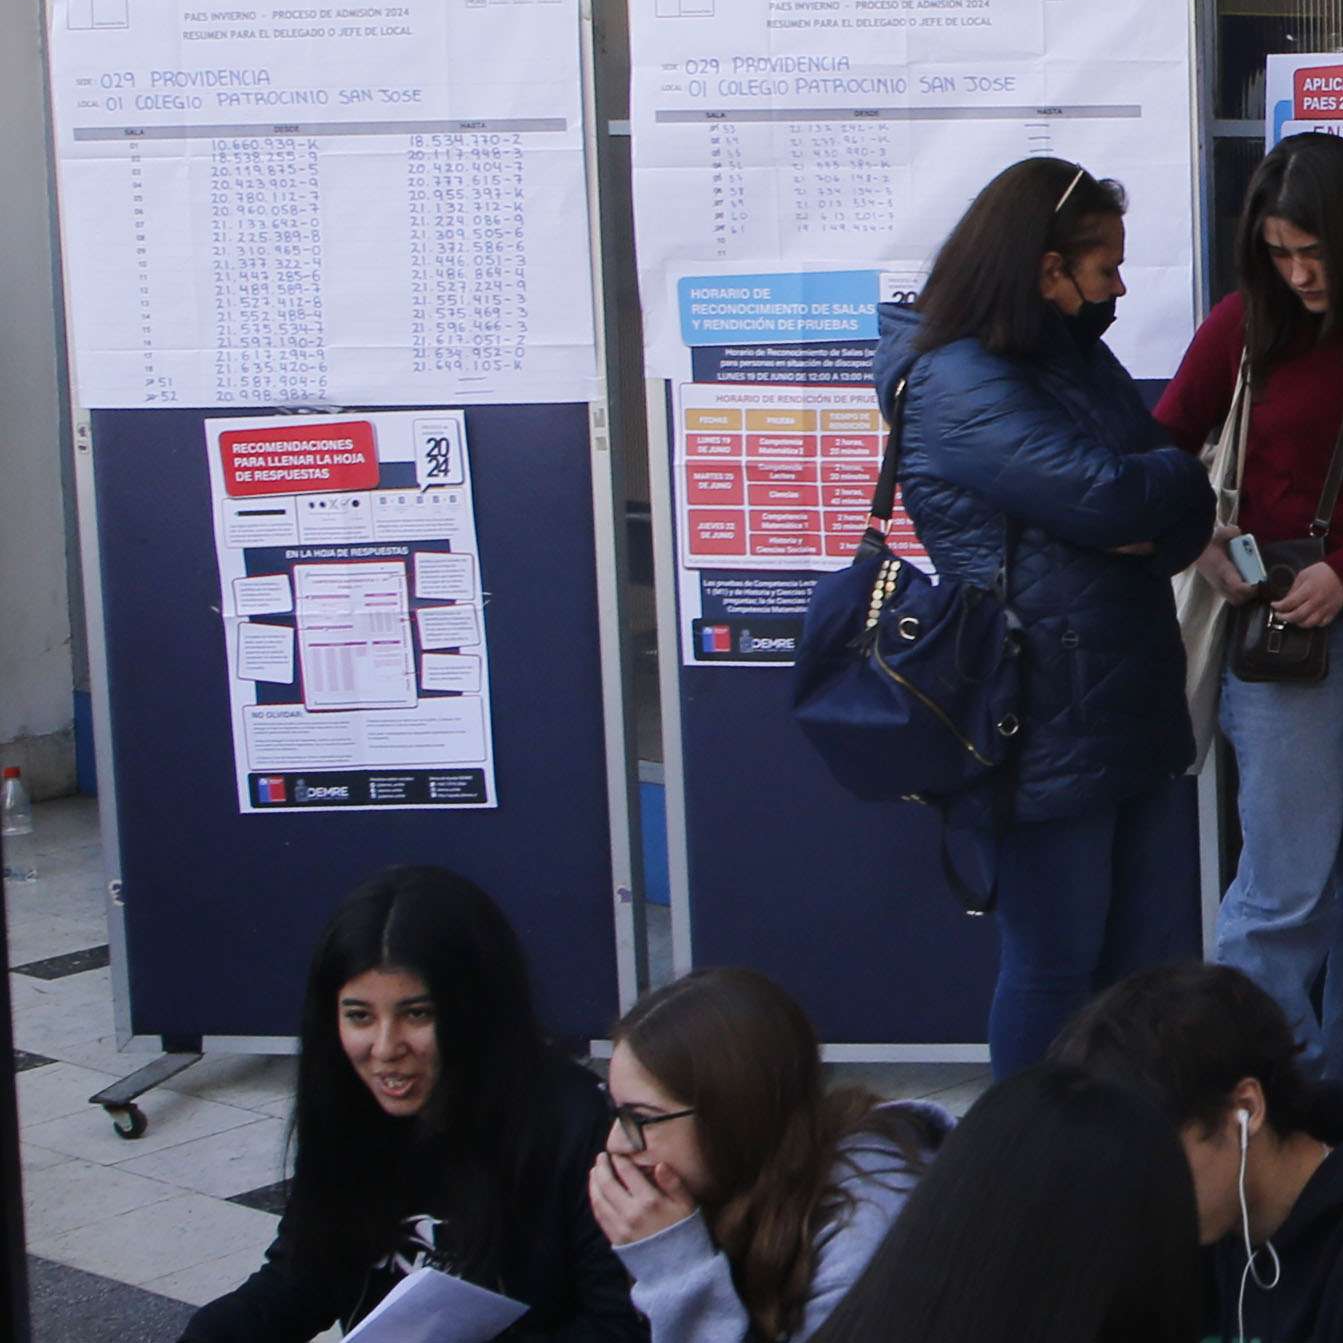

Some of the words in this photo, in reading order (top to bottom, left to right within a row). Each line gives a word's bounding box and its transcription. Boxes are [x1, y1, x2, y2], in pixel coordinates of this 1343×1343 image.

[769, 3, 792, 11] PAES
[795, 1, 840, 10] INVIERNO
[855, 1, 898, 10] PROCESO
[901, 0, 914, 8] DE
[966, 0, 990, 8] 2024
[211, 11, 256, 21] INVIERNO
[272, 10, 316, 20] PROCESO
[320, 9, 332, 18] DE
[385, 8, 410, 17] 2024
[766, 19, 811, 29] RESUMEN
[813, 19, 839, 28] PARA
[841, 19, 853, 27] EL
[856, 18, 906, 28] DELEGADO
[909, 18, 916, 26] O
[919, 17, 943, 26] JEFE
[945, 17, 958, 26] DE
[960, 17, 991, 26] LOCAL
[183, 30, 227, 40] RESUMEN
[230, 30, 255, 39] PARA
[258, 29, 270, 39] EL
[273, 28, 325, 39] DELEGADO
[328, 28, 335, 37] O
[338, 28, 362, 37] JEFE
[365, 27, 377, 36] DE
[381, 27, 412, 36] LOCAL
[685, 59, 719, 75] 029
[733, 56, 849, 73] PROVIDENCIA
[100, 72, 136, 89] 029
[150, 69, 271, 88] PROVIDENCIA
[718, 79, 789, 96] COLEGIO
[795, 77, 906, 94] PATROCINIO
[919, 77, 955, 94] SAN
[963, 76, 1016, 92] JOSE
[135, 93, 202, 111] COLEGIO
[216, 90, 328, 107] PATROCINIO
[339, 89, 373, 105] SAN
[378, 89, 422, 103] JOSE
[1303, 98, 1336, 110] PAES
[691, 289, 749, 299] HORARIO
[753, 289, 771, 298] DE
[691, 304, 808, 315] RECONOCIMIENTO
[811, 304, 829, 314] DE
[833, 304, 876, 314] SALAS
[692, 320, 701, 330] Y
[703, 318, 774, 330] RENDICIÓN
[778, 320, 794, 330] DE
[799, 319, 858, 329] PRUEBAS
[232, 439, 353, 453] RECOMENDACIONES
[427, 437, 449, 456] 20
[234, 457, 265, 467] PARA
[268, 456, 313, 467] LLENAR
[316, 455, 332, 465] LA
[334, 453, 365, 464] HOJA
[427, 457, 449, 477] 24
[235, 471, 252, 481] DE
[254, 468, 330, 480] RESPUESTAS
[286, 550, 299, 559] EN
[300, 550, 312, 558] LA
[336, 549, 348, 557] DE
[350, 546, 409, 557] RESPUESTAS
[306, 787, 348, 798] DEMRE
